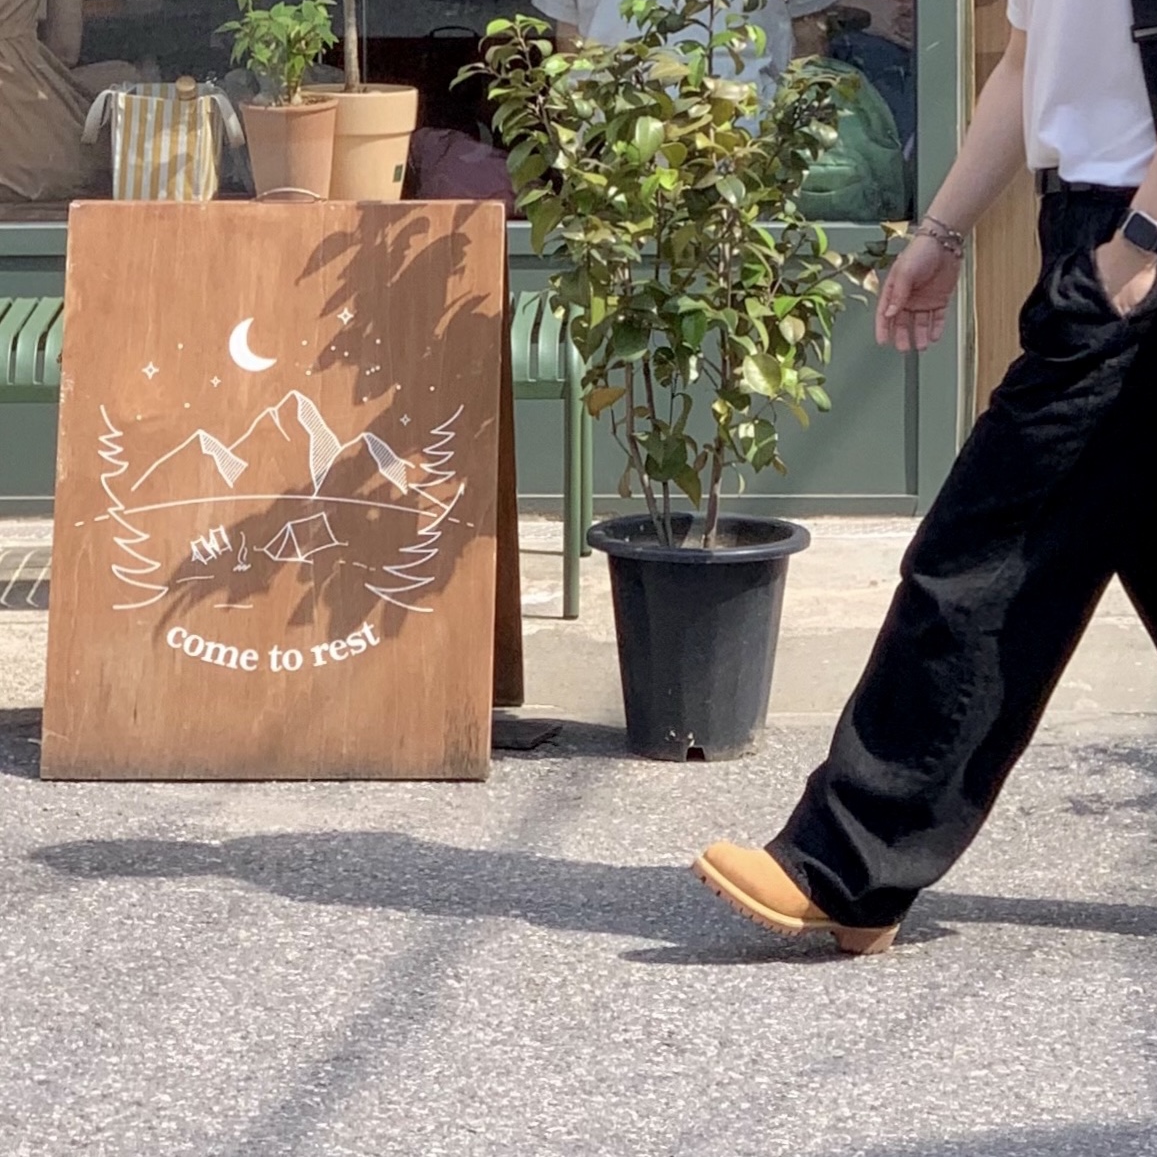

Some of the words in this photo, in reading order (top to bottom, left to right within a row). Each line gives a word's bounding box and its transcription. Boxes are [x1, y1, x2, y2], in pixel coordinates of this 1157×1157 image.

[165, 625, 260, 672] come
[267, 644, 305, 673] to
[309, 620, 381, 668] rest
